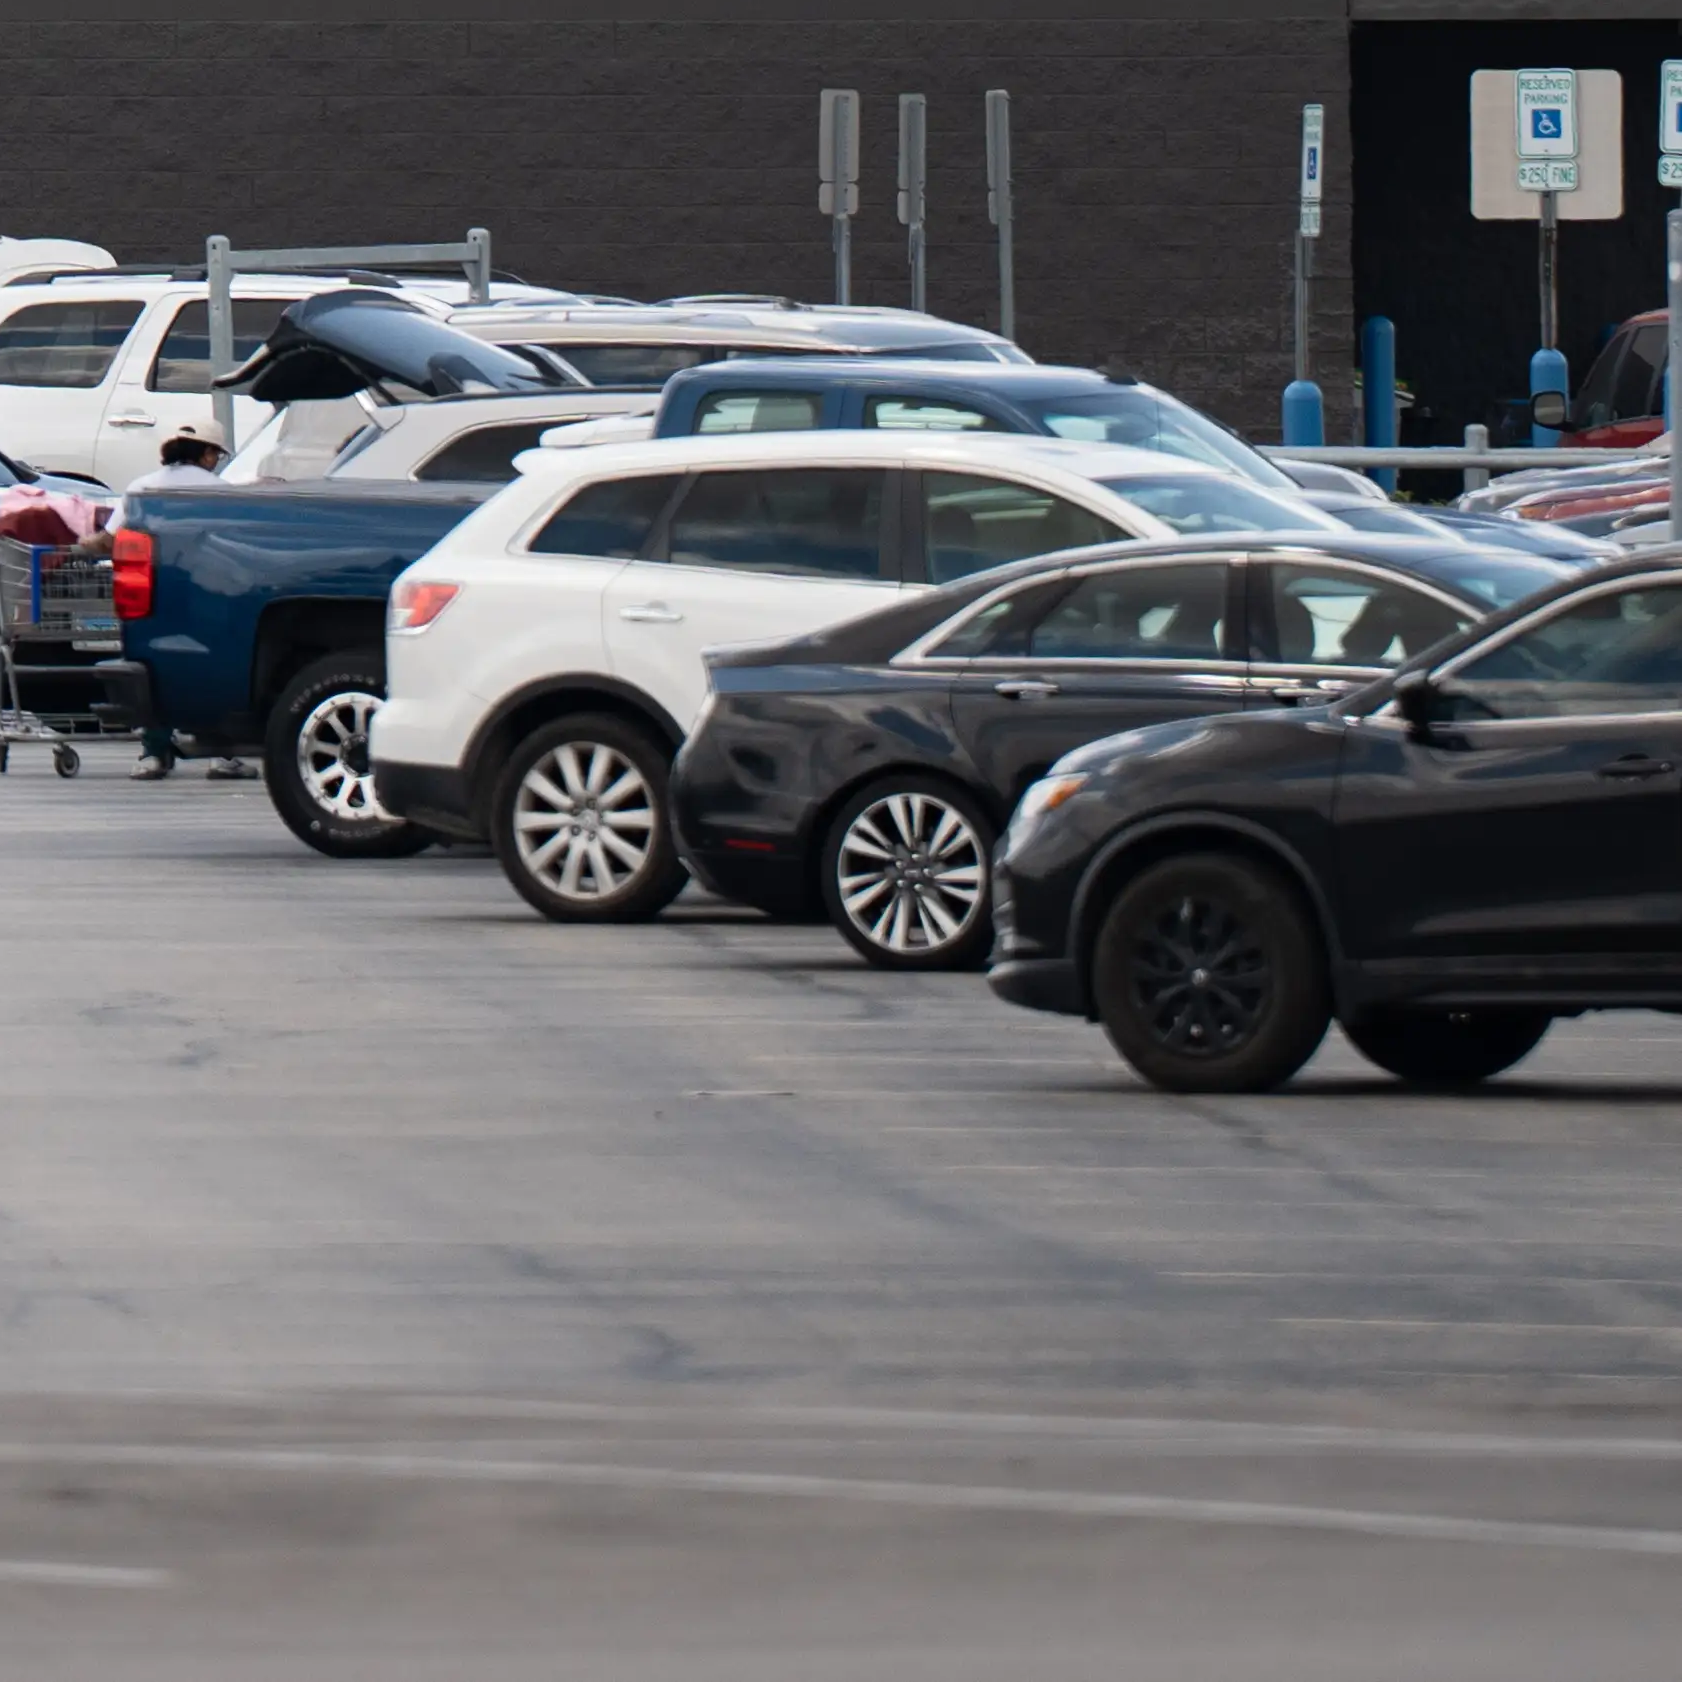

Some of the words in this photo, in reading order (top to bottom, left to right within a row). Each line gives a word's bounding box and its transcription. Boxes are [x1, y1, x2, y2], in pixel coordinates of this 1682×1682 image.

[1519, 78, 1571, 90] RESERVED
[1524, 92, 1568, 104] PARKING
[1552, 166, 1576, 184] FINE
